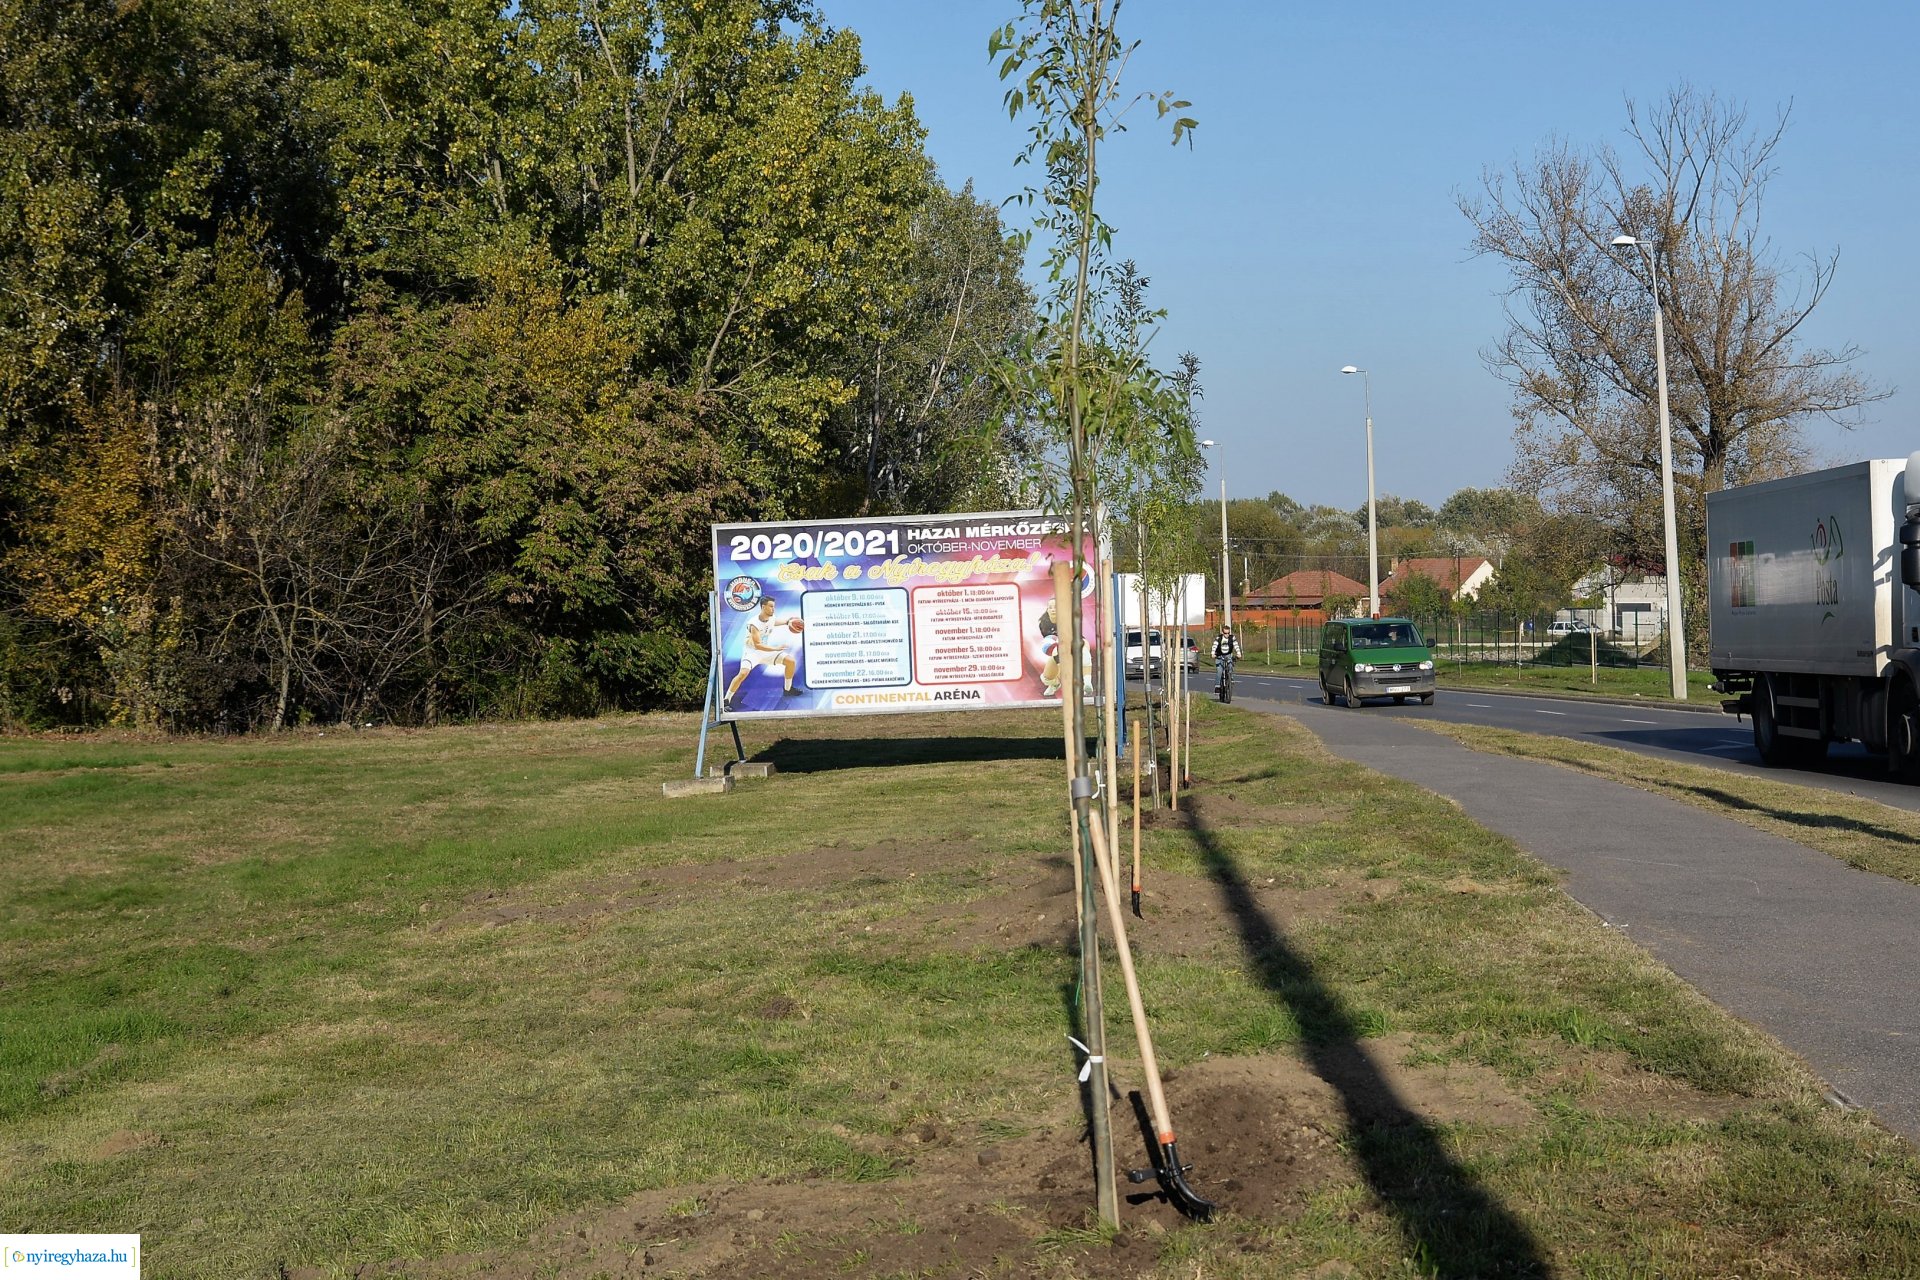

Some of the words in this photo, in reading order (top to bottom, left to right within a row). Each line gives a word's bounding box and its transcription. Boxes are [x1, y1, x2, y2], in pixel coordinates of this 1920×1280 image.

[907, 528, 960, 541] HAZAI
[730, 529, 899, 561] 2020/2021
[907, 538, 1042, 554] OKTÓBER-NOVEMBER
[777, 560, 839, 583] Csak
[843, 564, 862, 579] a
[937, 589, 963, 597] október
[1816, 570, 1839, 606] Posta
[935, 627, 968, 635] november
[935, 646, 968, 654] november
[835, 692, 931, 705] CONTINENTAL
[934, 688, 981, 700] ARÉNA
